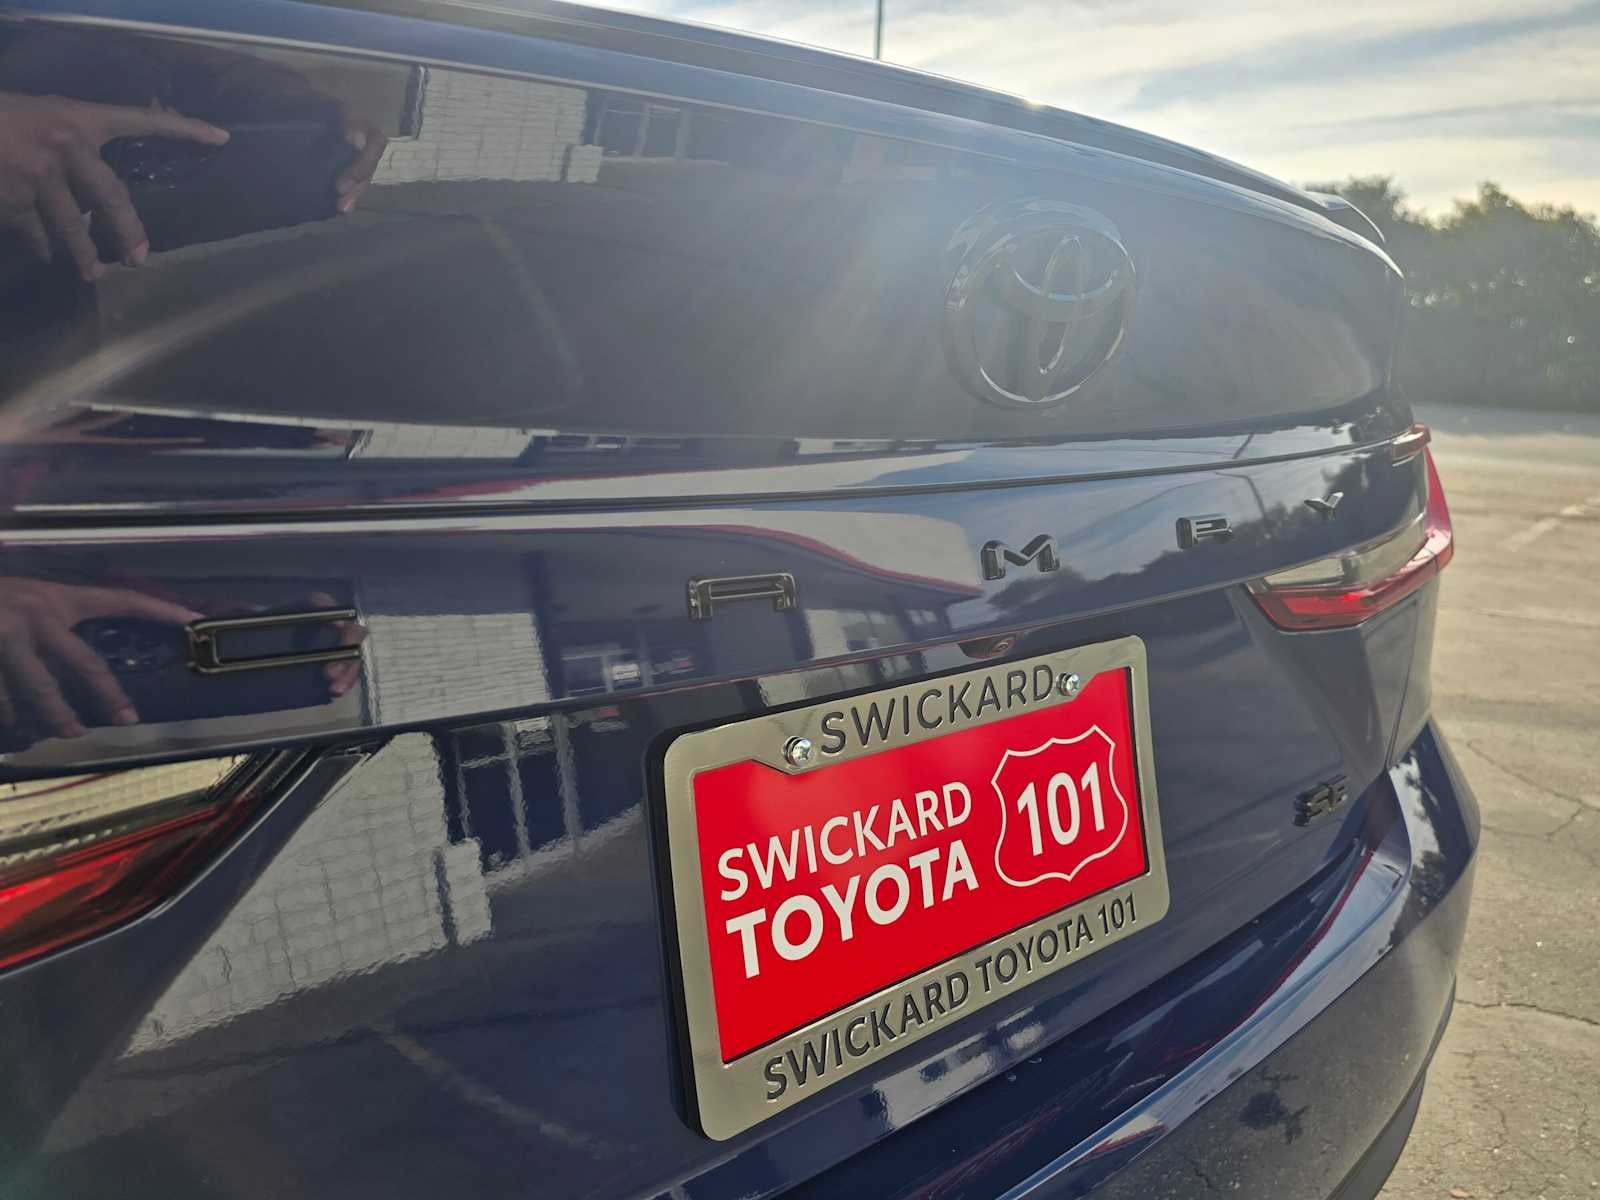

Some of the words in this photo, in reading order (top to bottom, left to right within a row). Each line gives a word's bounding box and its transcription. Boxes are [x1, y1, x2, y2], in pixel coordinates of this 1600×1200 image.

[186, 491, 1345, 674] CAMRY
[820, 664, 1055, 755] SWICKARD
[719, 780, 972, 901] SWICKARD
[1016, 761, 1106, 857] 101
[725, 839, 980, 979] TOYOTA
[764, 970, 969, 1101] SWICKARD
[977, 917, 1093, 994] TOYOTA
[1097, 893, 1138, 936] 101
